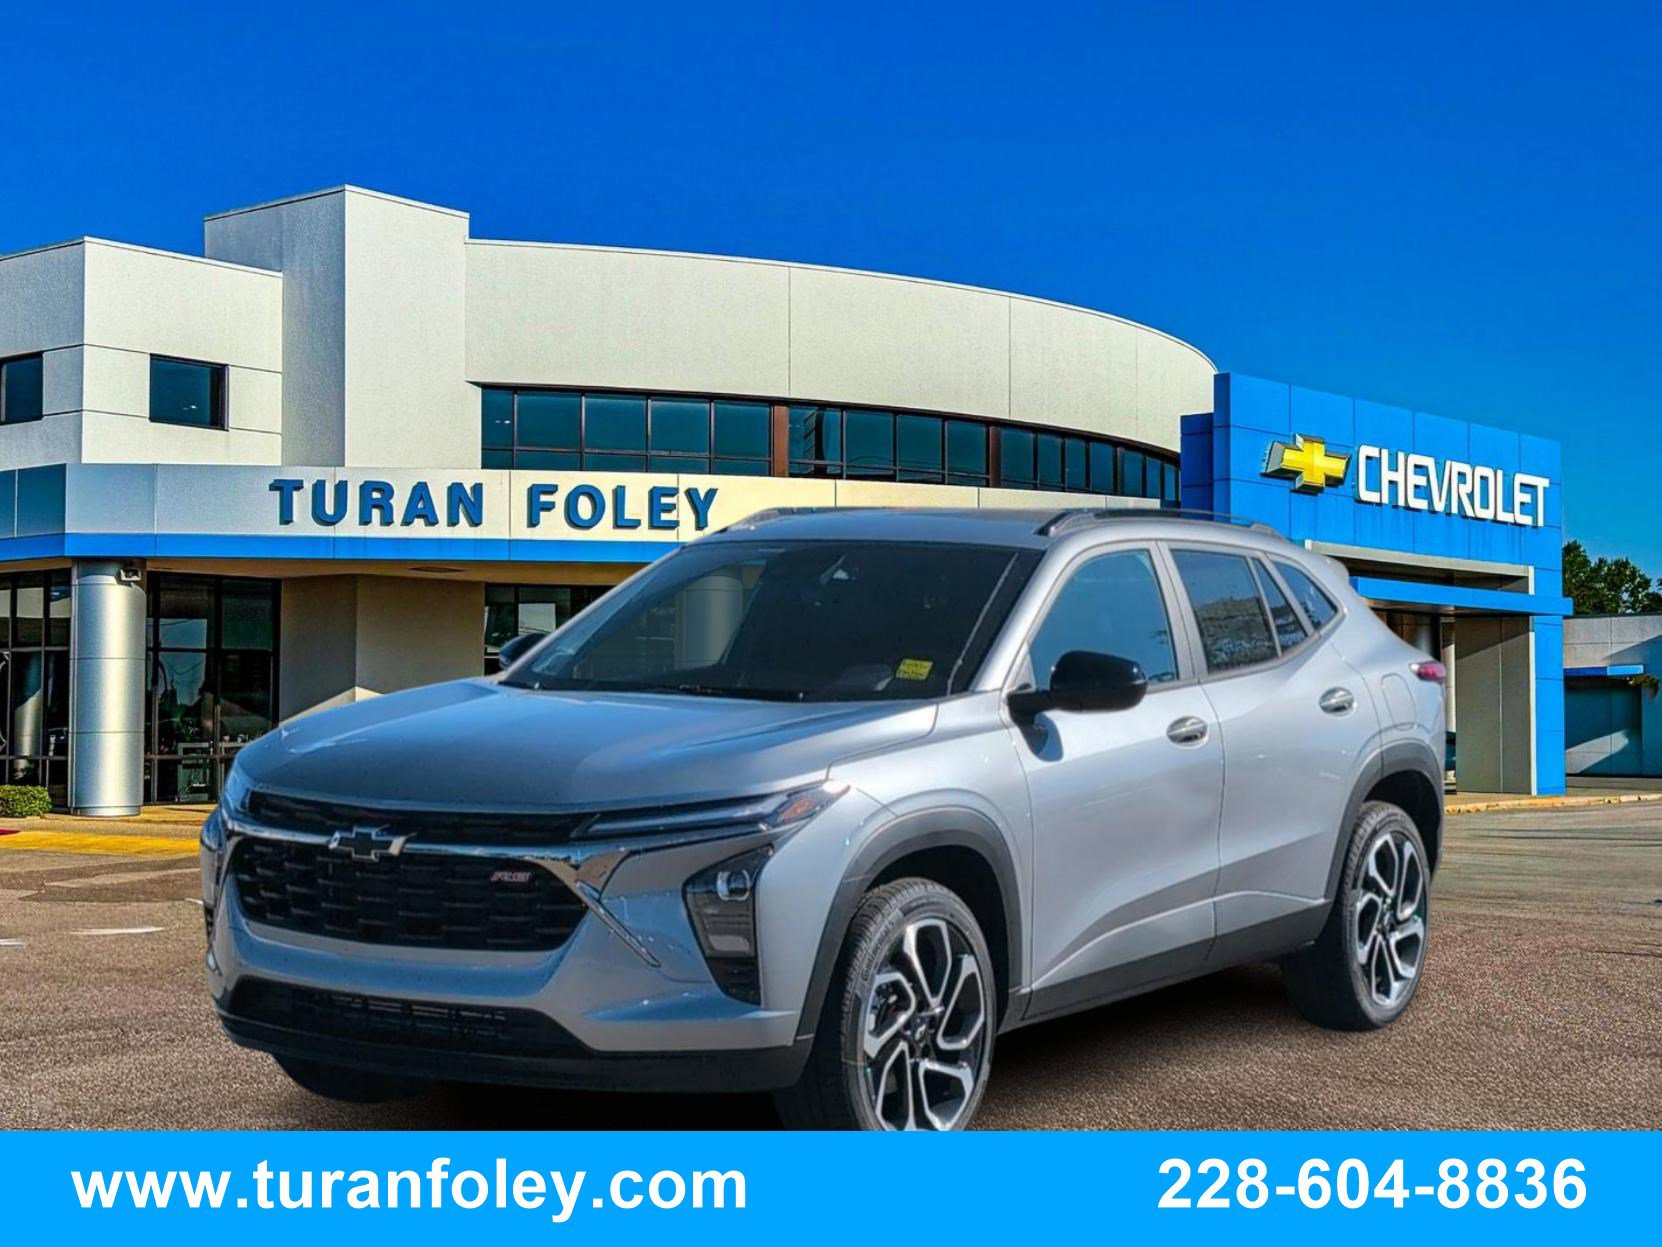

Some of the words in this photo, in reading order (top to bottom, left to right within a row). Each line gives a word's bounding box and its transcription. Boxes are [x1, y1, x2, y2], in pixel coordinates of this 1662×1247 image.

[269, 478, 484, 527] TURAN
[526, 483, 719, 531] FOLEY
[1358, 445, 1550, 527] CHEVROLET
